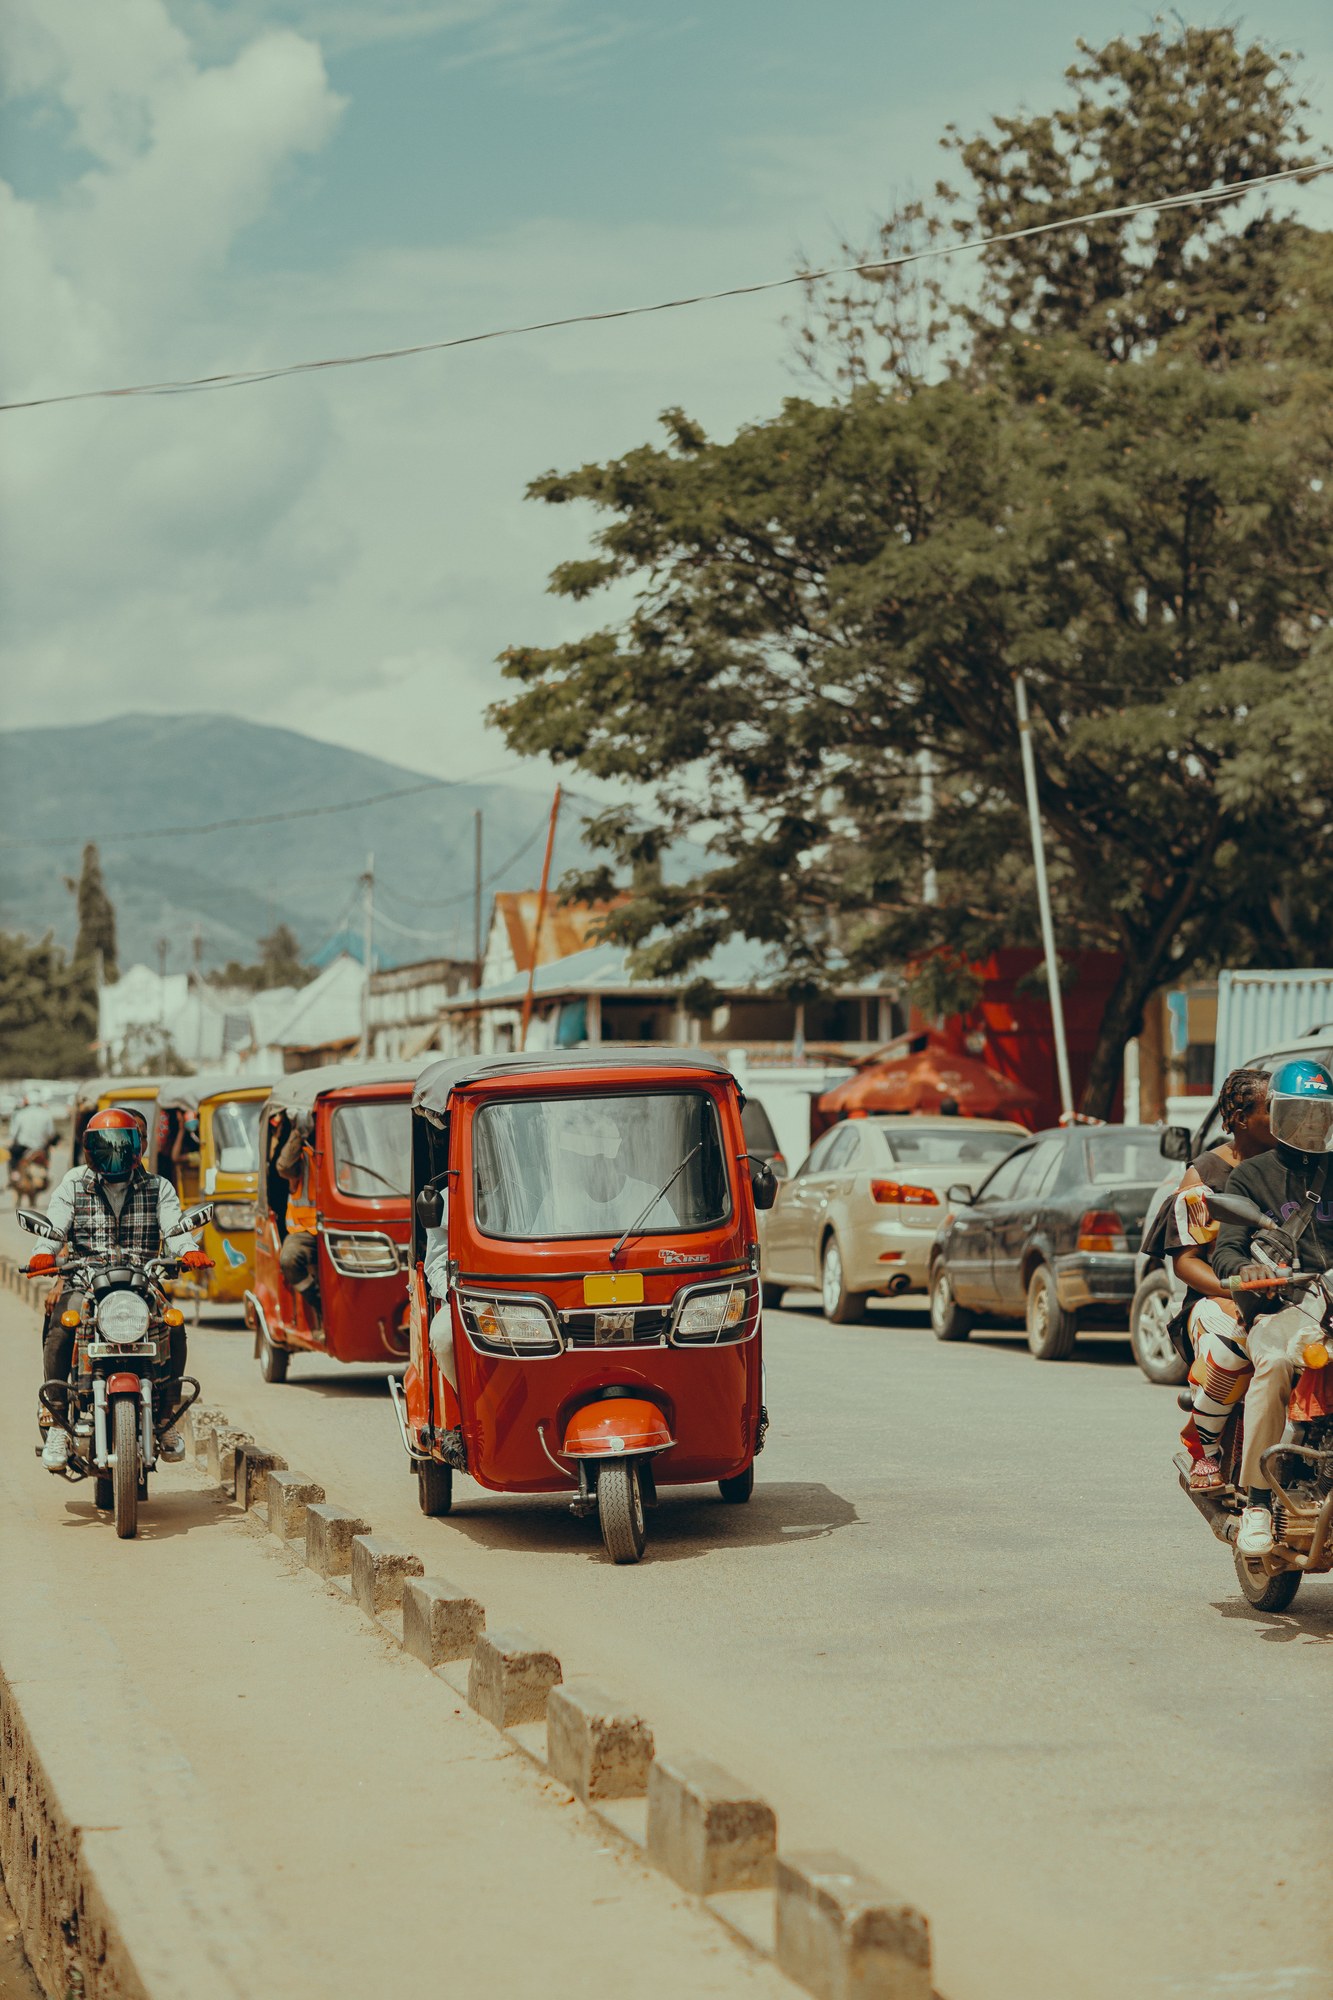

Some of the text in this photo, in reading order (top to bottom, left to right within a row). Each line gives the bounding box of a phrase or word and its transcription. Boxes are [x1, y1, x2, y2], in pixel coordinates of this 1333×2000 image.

[1304, 1081, 1328, 1091] TVS
[660, 1249, 677, 1257] TVS
[597, 1313, 634, 1329] TVS
